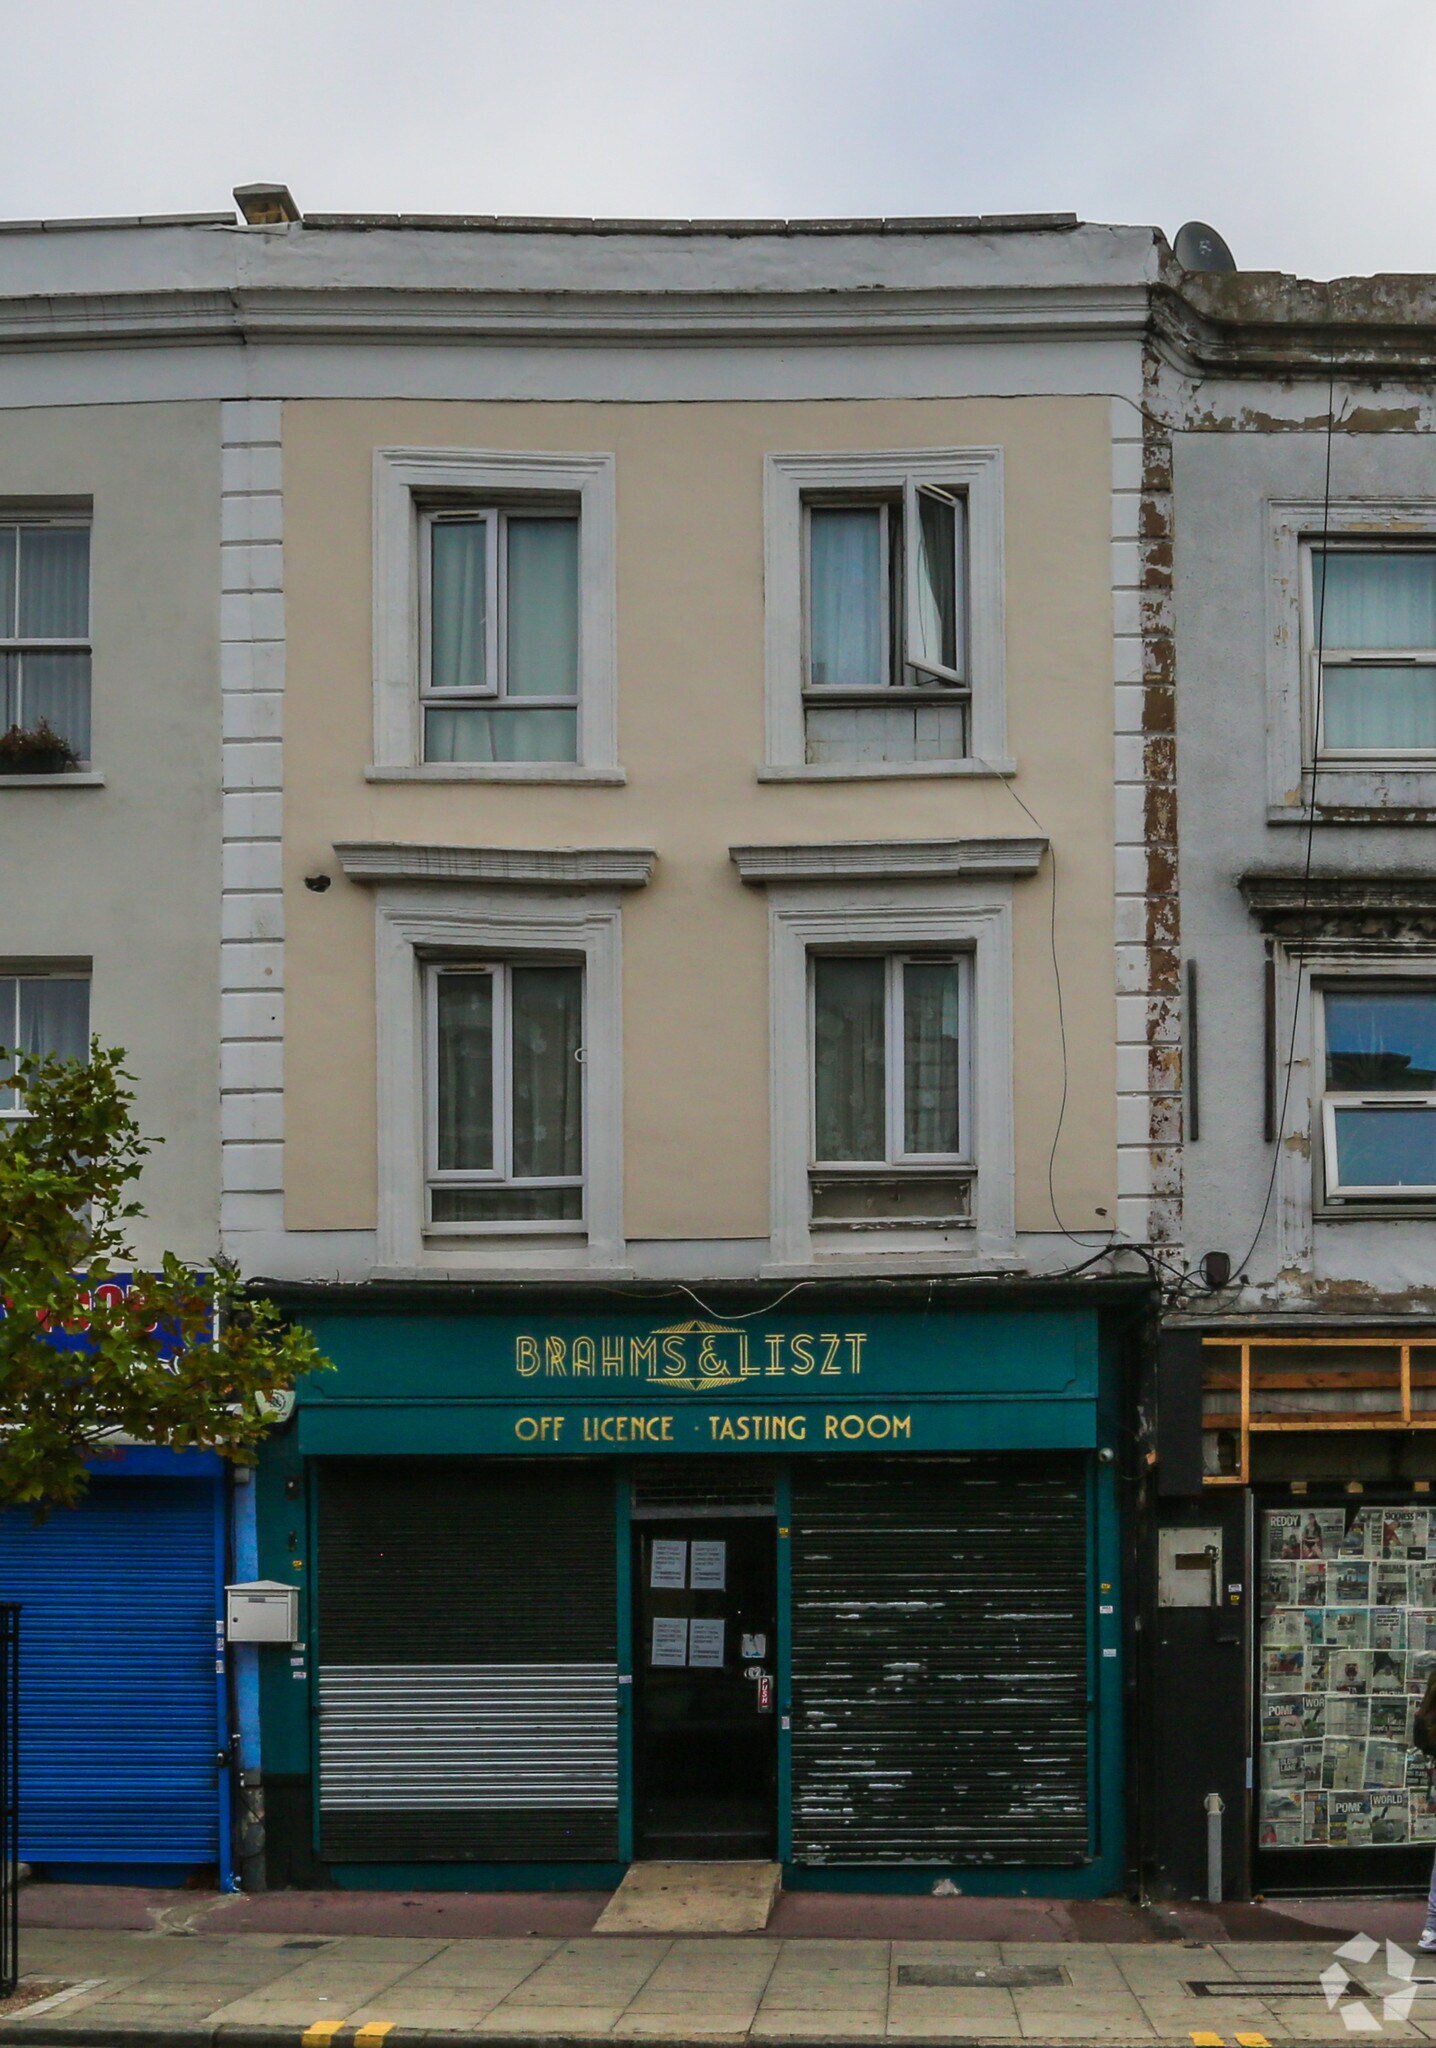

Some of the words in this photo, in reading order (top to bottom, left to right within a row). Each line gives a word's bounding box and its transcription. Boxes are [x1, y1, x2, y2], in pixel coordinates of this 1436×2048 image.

[515, 1335, 687, 1377] BRAHMS
[698, 1334, 731, 1376] &
[740, 1333, 868, 1376] LISZT
[514, 1416, 565, 1441] OFF
[583, 1415, 674, 1442] LICENCE
[709, 1415, 806, 1441] TASTING
[825, 1414, 912, 1440] ROOM
[761, 1678, 769, 1704] PUSH
